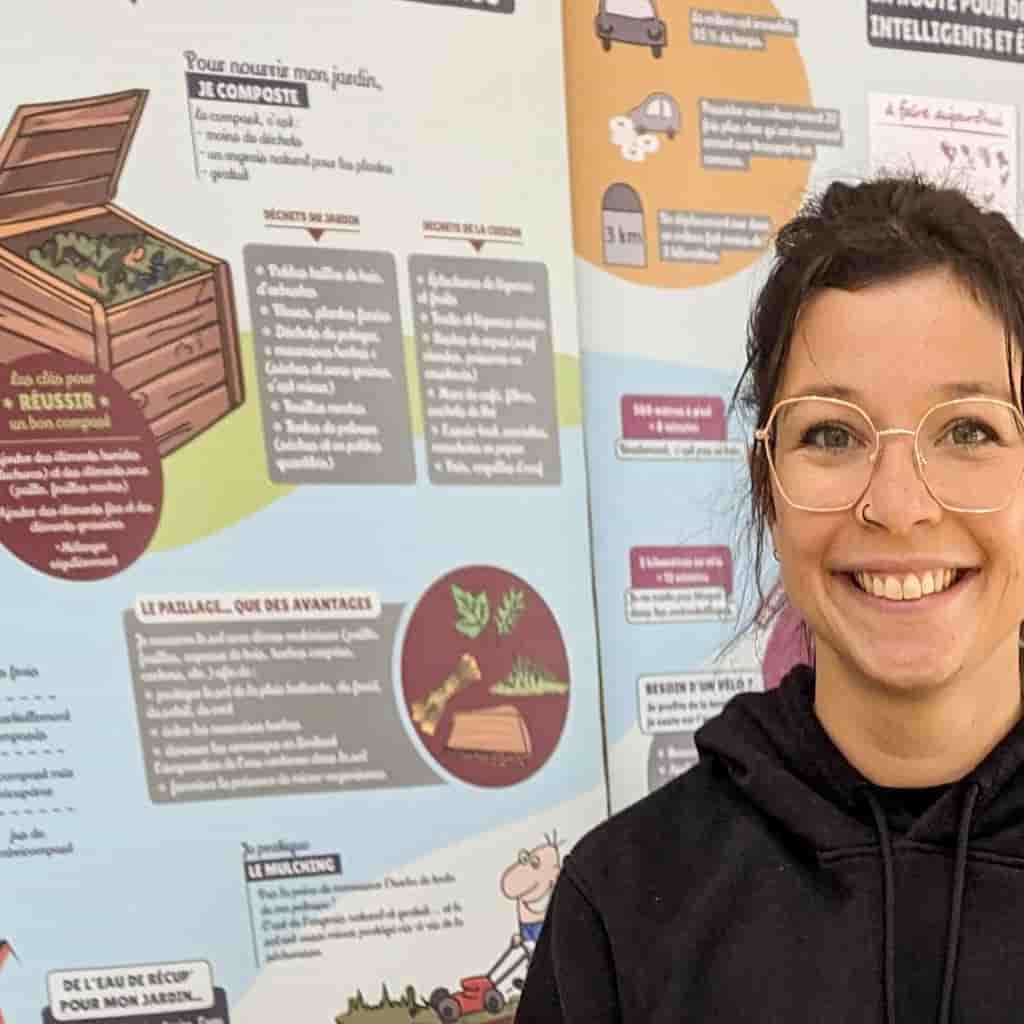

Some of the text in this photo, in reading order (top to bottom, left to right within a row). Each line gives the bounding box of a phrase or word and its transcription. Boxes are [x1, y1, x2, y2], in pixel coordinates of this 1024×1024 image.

[870, 14, 993, 52] INTELLIGENTS
[995, 29, 1014, 55] ET
[183, 50, 225, 73] Pour
[229, 58, 290, 79] nourrir
[293, 66, 329, 83] mon
[198, 79, 300, 105] JE COMPOSTE
[607, 225, 615, 242] 3
[18, 389, 96, 412] RÉUSSIR
[139, 600, 157, 616] LE
[233, 598, 263, 615] QUE
[265, 596, 289, 613] DES
[291, 595, 373, 612] AVANTAGES
[248, 856, 337, 879] LE MULCHING
[63, 968, 194, 993] DE L'EAU DE RÉCUP'
[59, 997, 100, 1013] POUR
[102, 993, 139, 1010] MON
